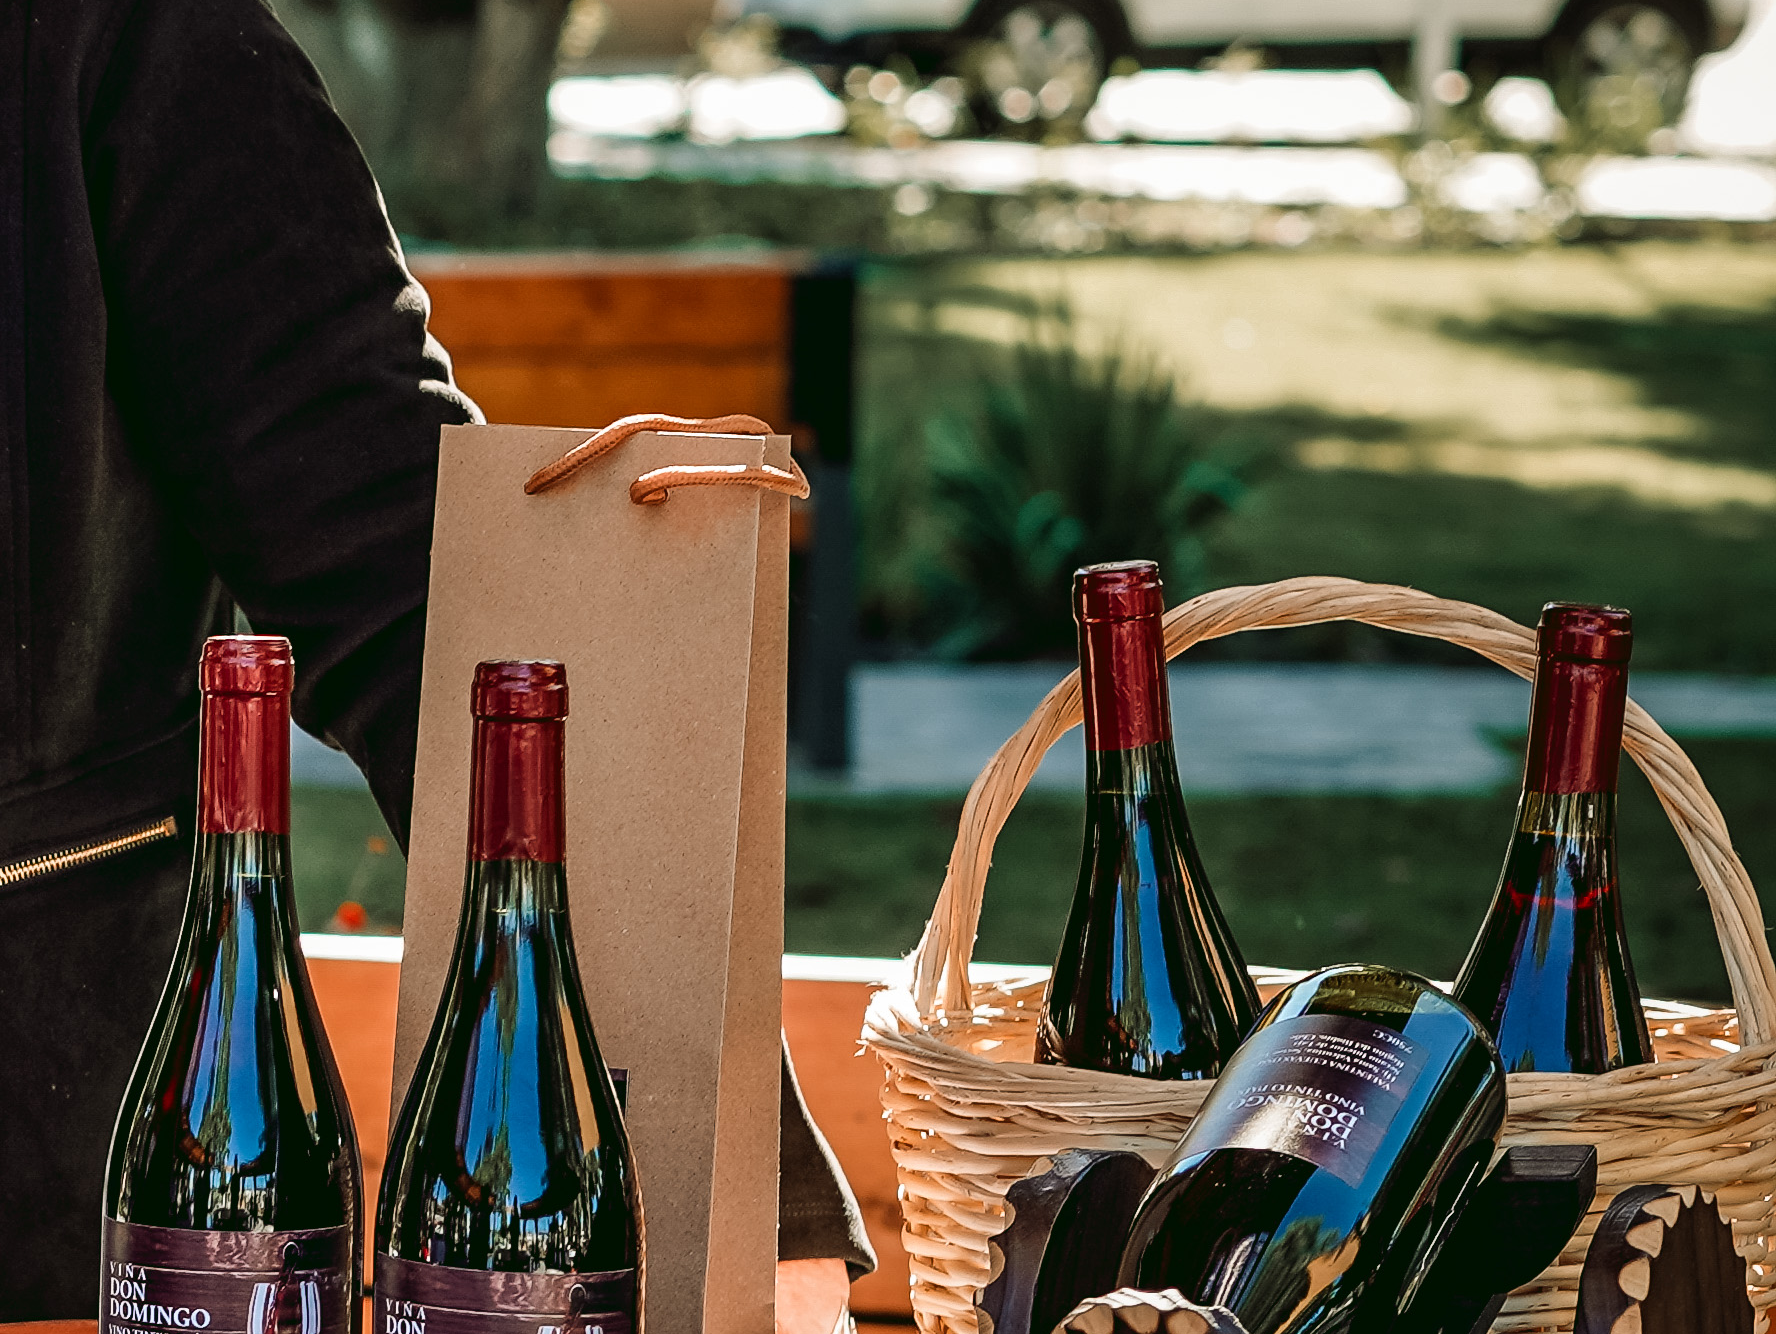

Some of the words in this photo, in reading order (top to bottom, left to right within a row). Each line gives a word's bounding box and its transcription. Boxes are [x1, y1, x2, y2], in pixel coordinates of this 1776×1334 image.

[1329, 1061, 1391, 1091] VALENTINA
[1271, 1083, 1322, 1099] TINTO
[1227, 1095, 1358, 1129] DOMINGO
[1325, 1093, 1366, 1116] VINO
[1293, 1109, 1352, 1140] DON
[110, 1261, 146, 1280] VIÑA
[110, 1277, 146, 1301] DON
[110, 1297, 211, 1328] DOMINGO
[386, 1298, 426, 1320] VIÑA
